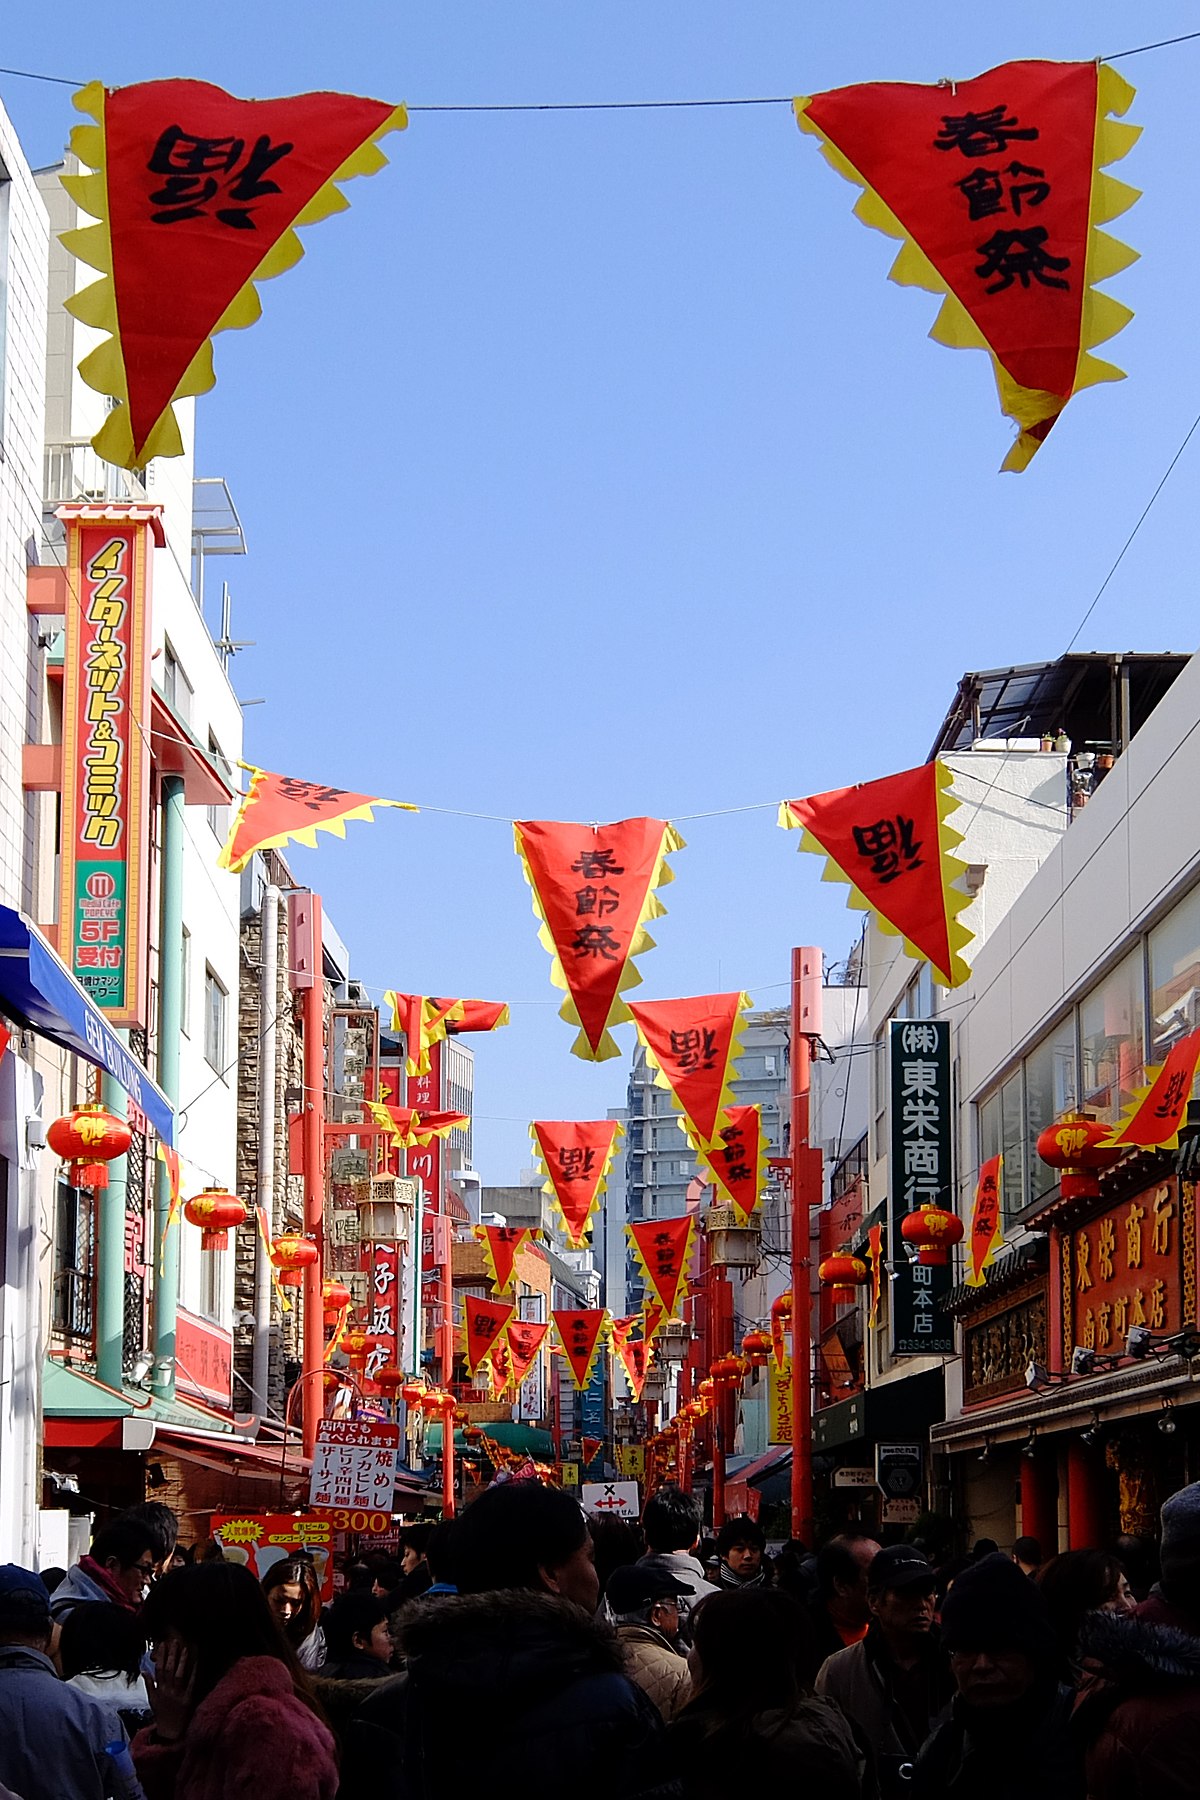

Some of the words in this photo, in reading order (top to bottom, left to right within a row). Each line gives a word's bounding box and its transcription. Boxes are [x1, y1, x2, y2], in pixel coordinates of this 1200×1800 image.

[933, 104, 1070, 294] 春節祭
[85, 537, 127, 848] インターネット&コミック
[570, 847, 626, 961] 春節祭
[80, 920, 120, 943] 5F
[75, 945, 122, 969] 受付
[84, 987, 118, 998] ャワー
[900, 1022, 940, 1211] (株)東栄商行
[318, 1431, 396, 1447] 食べられます
[319, 1420, 371, 1434] 店内でも
[373, 1449, 395, 1509] 焼めし
